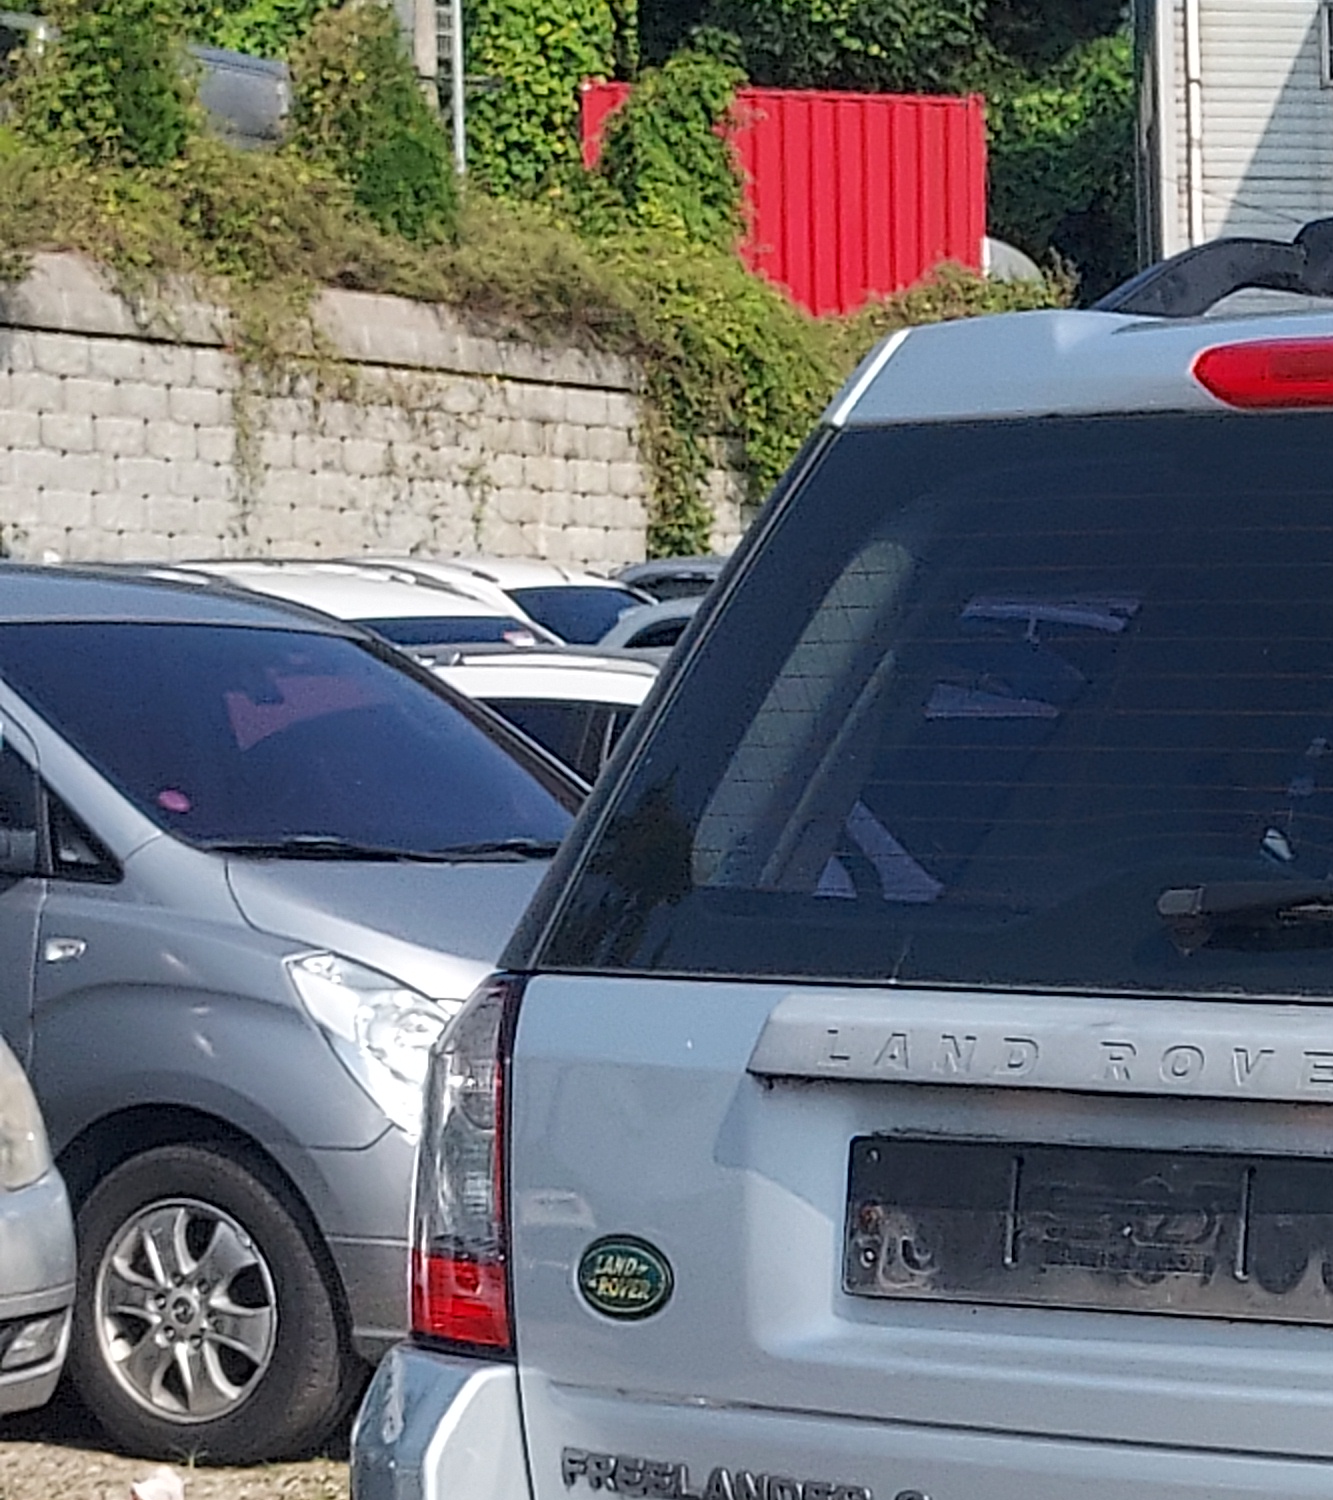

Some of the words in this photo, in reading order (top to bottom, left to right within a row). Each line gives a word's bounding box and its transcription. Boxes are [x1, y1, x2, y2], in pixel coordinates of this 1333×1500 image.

[820, 1028, 1040, 1077] LAND
[595, 1255, 638, 1276] LAND
[597, 1276, 650, 1300] ROVER
